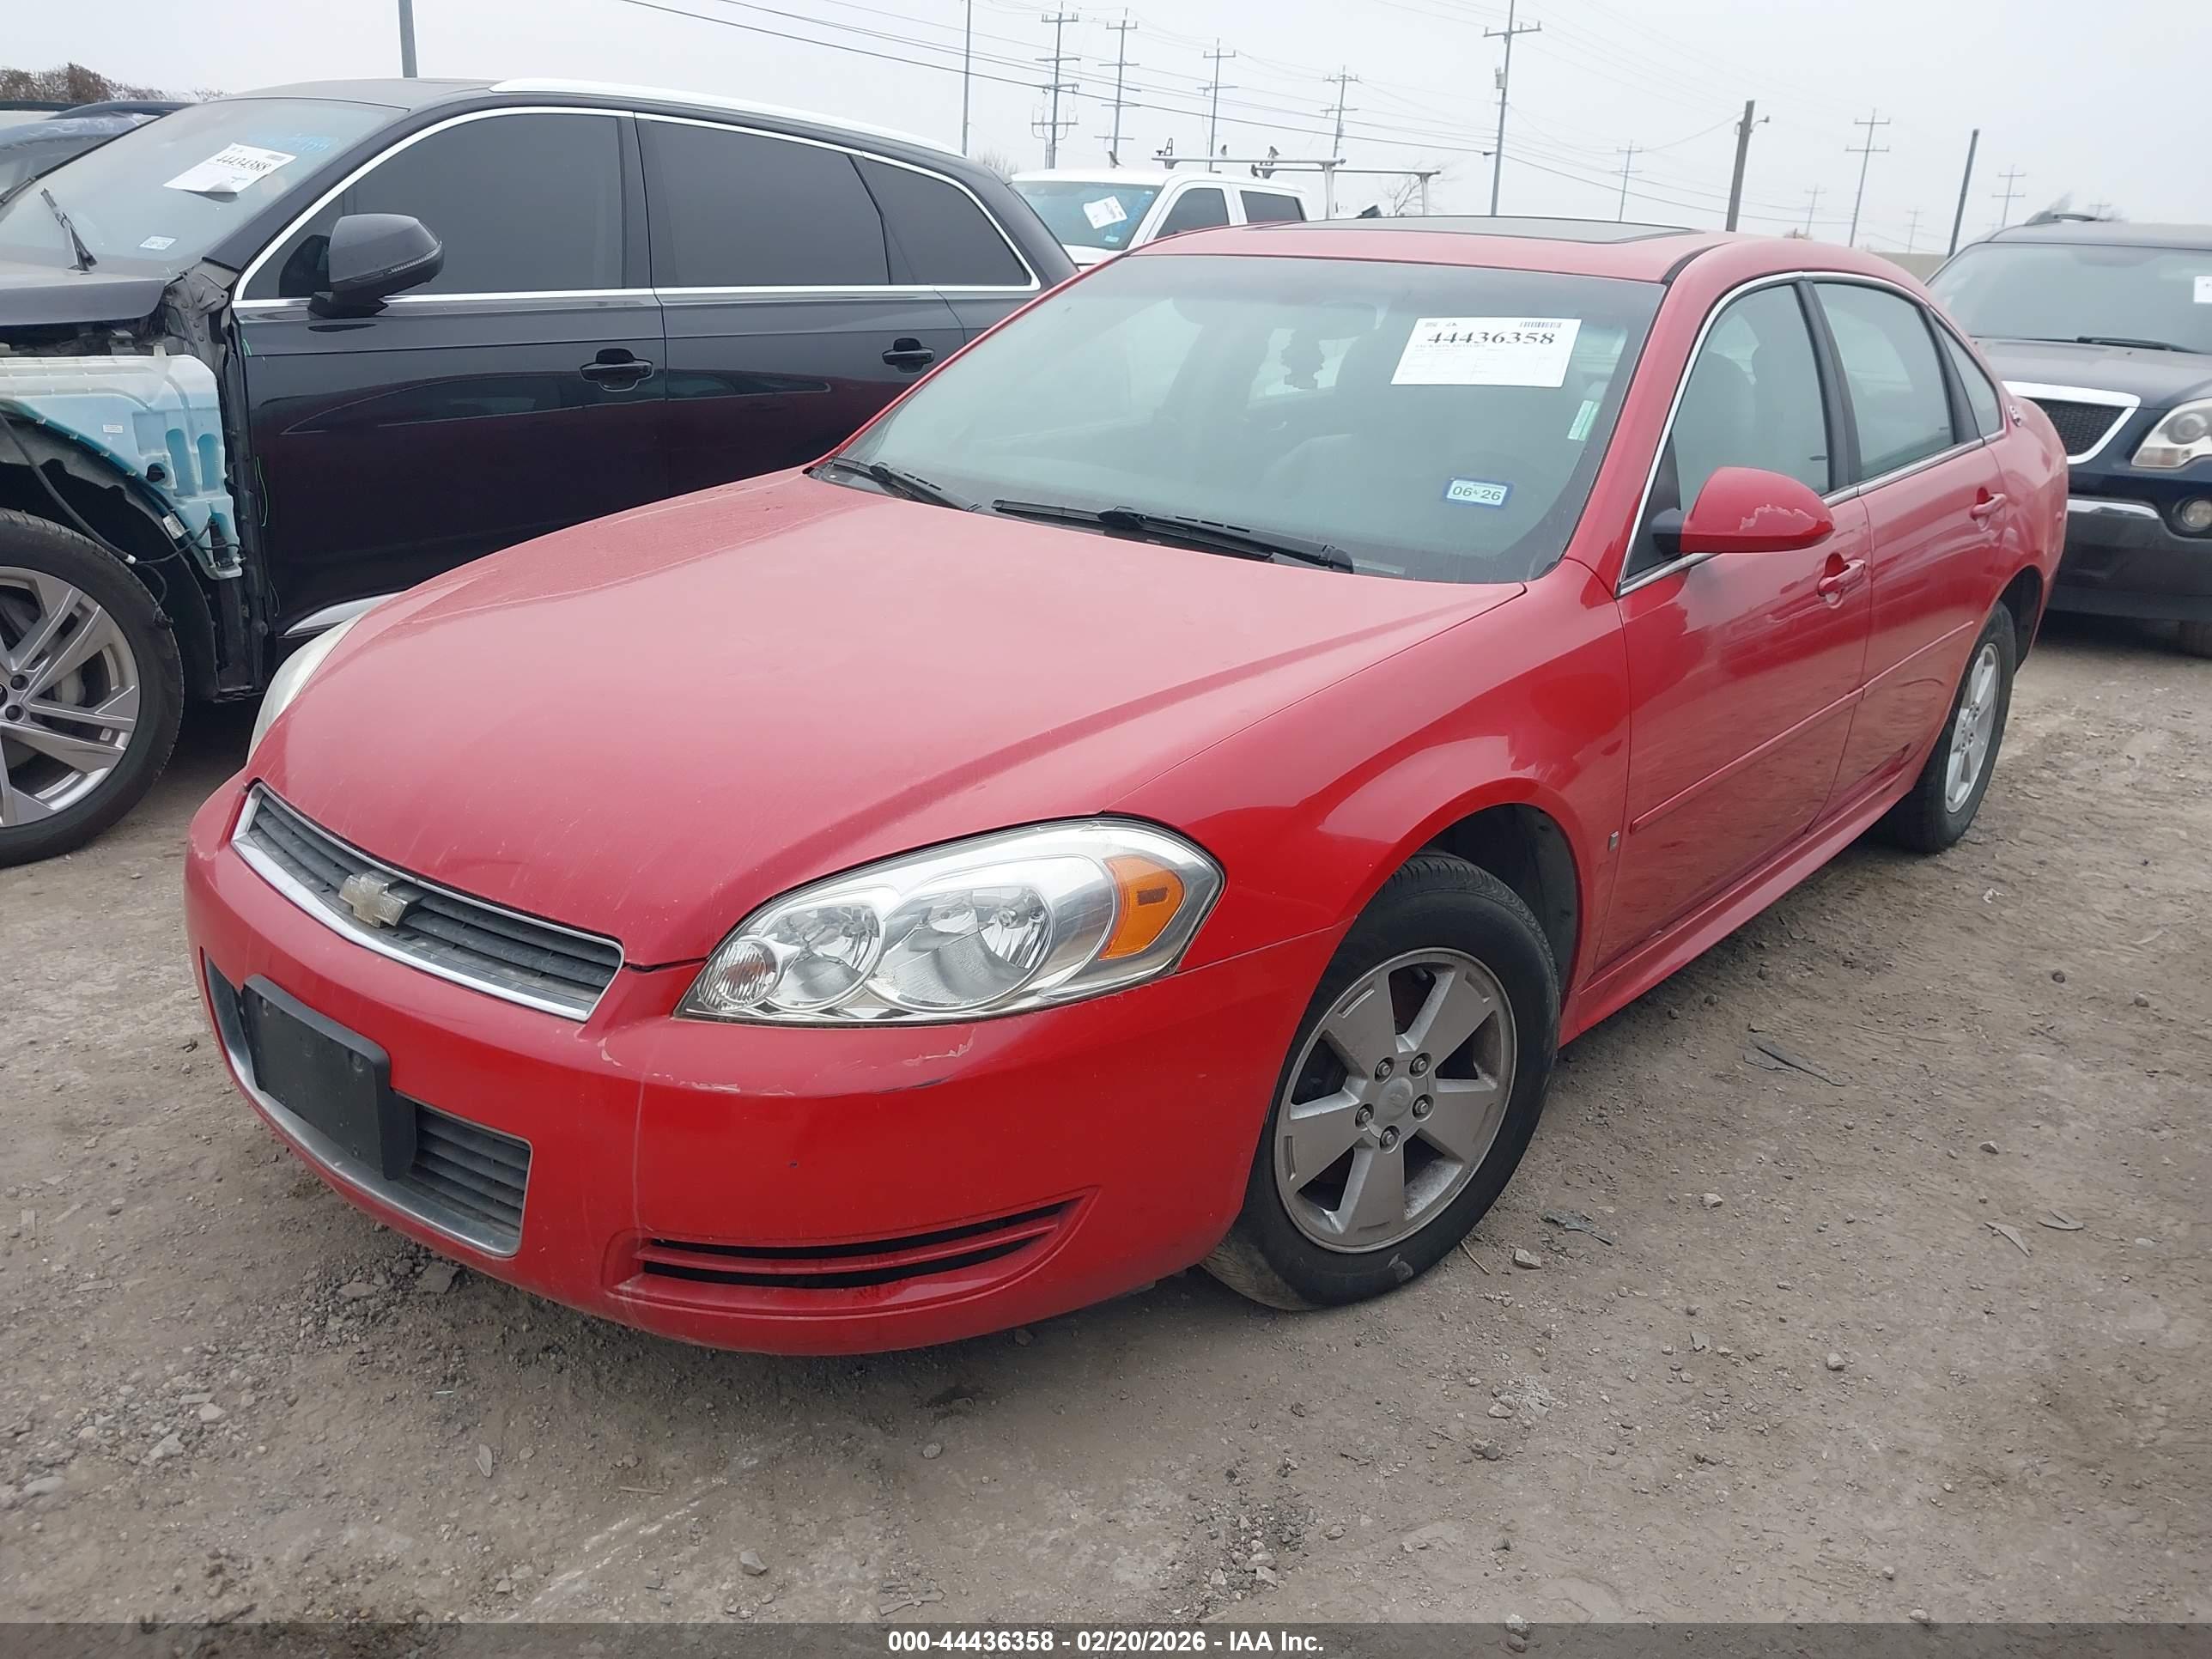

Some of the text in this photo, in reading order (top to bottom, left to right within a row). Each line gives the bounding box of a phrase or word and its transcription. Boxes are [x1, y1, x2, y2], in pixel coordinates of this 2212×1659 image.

[1428, 331, 1555, 344] 44436358
[1453, 486, 1502, 501] 06 26
